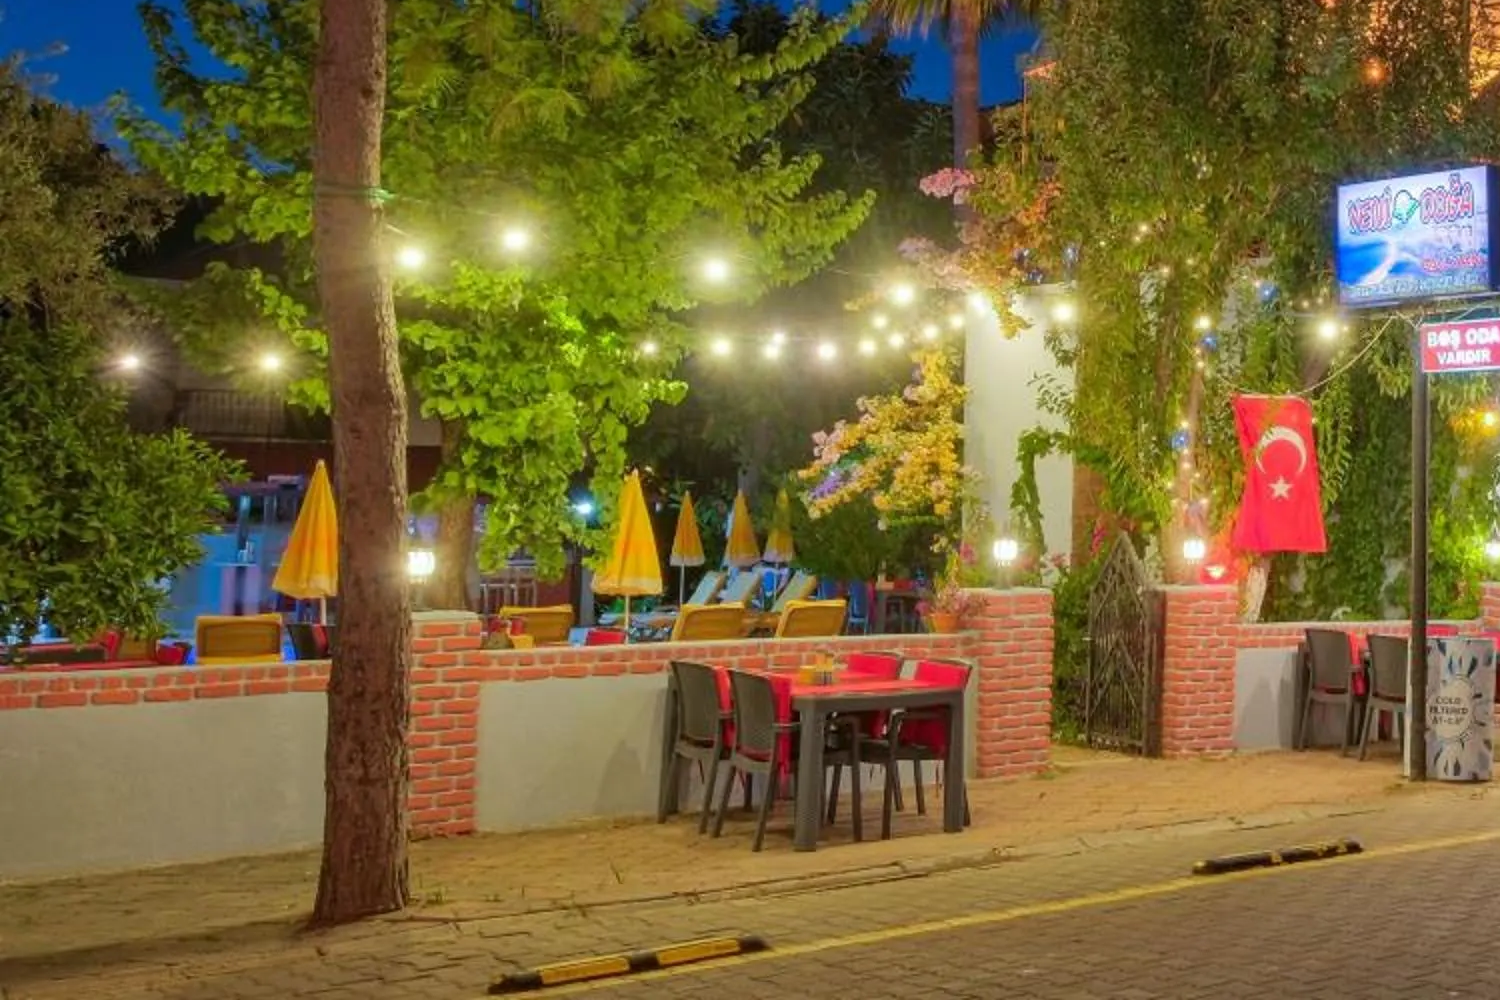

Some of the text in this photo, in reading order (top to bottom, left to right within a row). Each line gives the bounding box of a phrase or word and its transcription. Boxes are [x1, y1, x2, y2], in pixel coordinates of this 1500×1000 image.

[1427, 325, 1500, 351] BOŞ ODA
[1436, 349, 1491, 365] VARDIR
